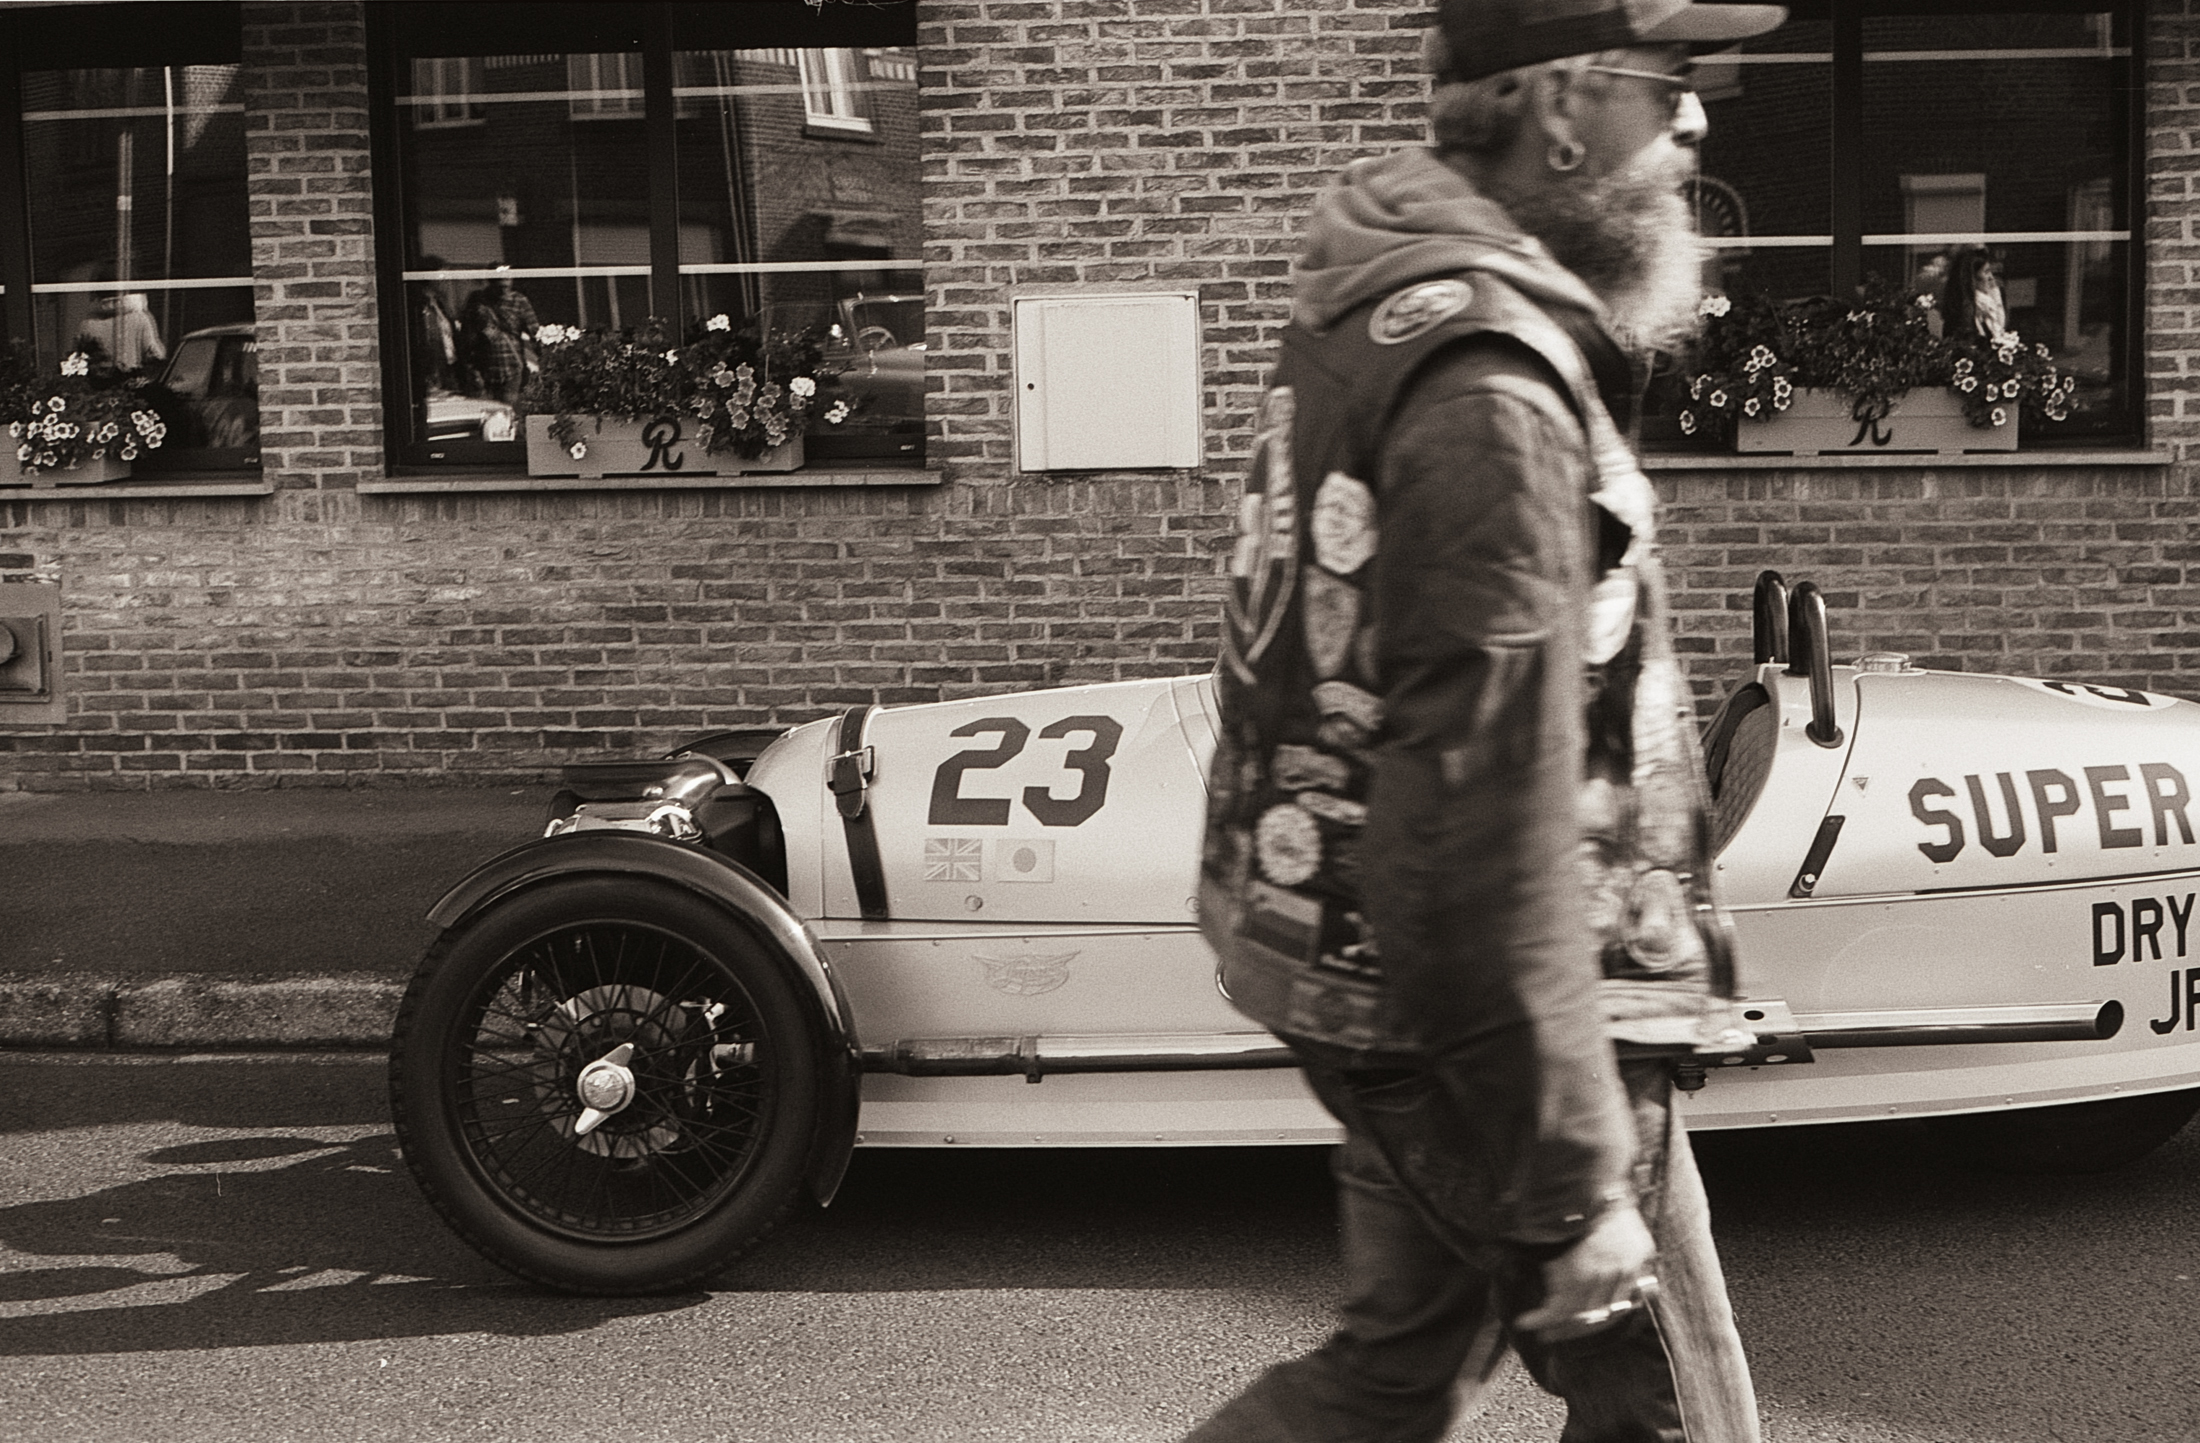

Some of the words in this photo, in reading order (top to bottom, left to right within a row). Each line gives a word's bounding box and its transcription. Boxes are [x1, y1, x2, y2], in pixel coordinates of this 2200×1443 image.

[640, 416, 684, 471] R
[1848, 391, 1892, 446] R
[928, 715, 1124, 827] 23
[1908, 762, 2197, 864] SUPER
[2092, 893, 2196, 966] DRY
